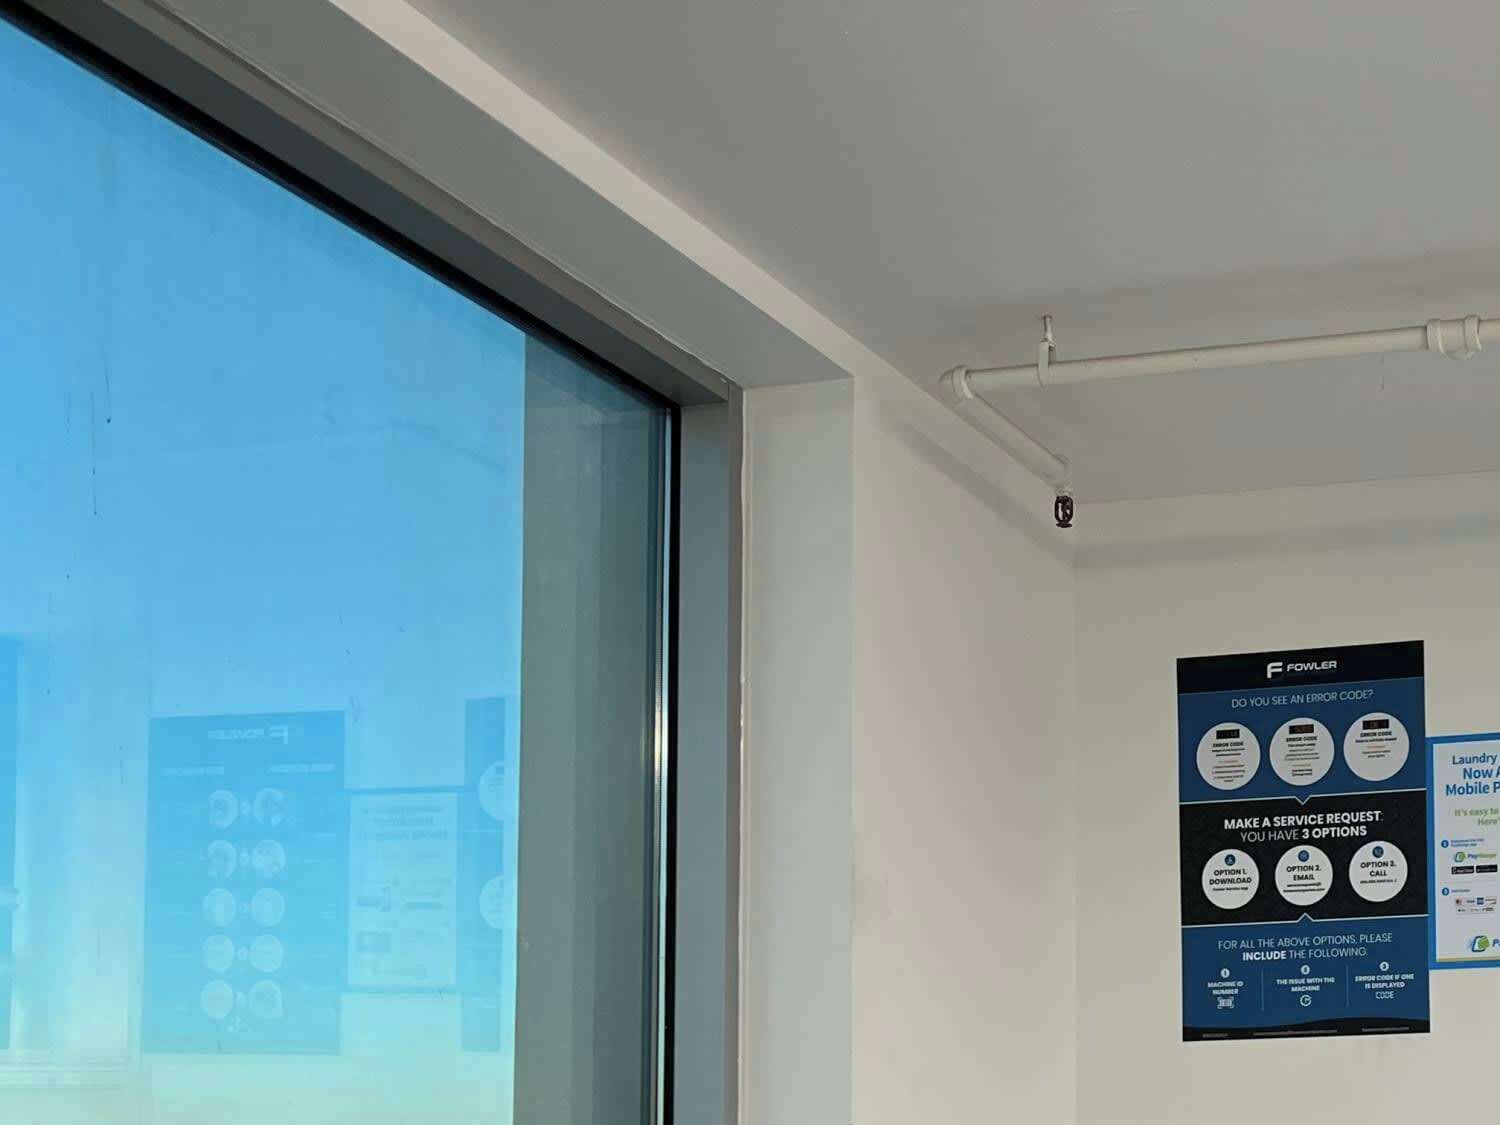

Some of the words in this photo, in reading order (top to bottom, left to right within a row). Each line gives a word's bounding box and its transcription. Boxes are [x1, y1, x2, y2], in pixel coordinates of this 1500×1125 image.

[1286, 661, 1337, 672] FOWLER
[1231, 698, 1248, 709] DO
[1249, 696, 1270, 707] YOU
[1272, 695, 1288, 705] SEE
[1290, 694, 1304, 704] AN
[1306, 692, 1337, 703] ERROR
[1339, 689, 1374, 701] CODE?
[1452, 752, 1497, 765] Laundry
[1462, 768, 1493, 780] Now
[1446, 781, 1490, 796] Mobile
[1468, 809, 1488, 819] easy
[1224, 818, 1260, 830] MAKE
[1262, 817, 1272, 828] A
[1273, 814, 1324, 827] SERVICE
[1240, 832, 1265, 842] YOU
[1268, 830, 1299, 841] HAVE
[1302, 829, 1310, 839] 3
[1312, 825, 1367, 839] OPTIONS
[1286, 865, 1314, 873] OPTION
[1360, 861, 1389, 869] OPTION
[1209, 877, 1252, 885] DOWNLOAD
[1218, 940, 1237, 950] FOR
[1240, 939, 1255, 949] ALL
[1258, 938, 1275, 948] THE
[1277, 936, 1310, 947] ABOVE
[1359, 932, 1393, 944] PLEASE
[1242, 950, 1287, 961] INCLUDE
[1289, 950, 1306, 959] THE
